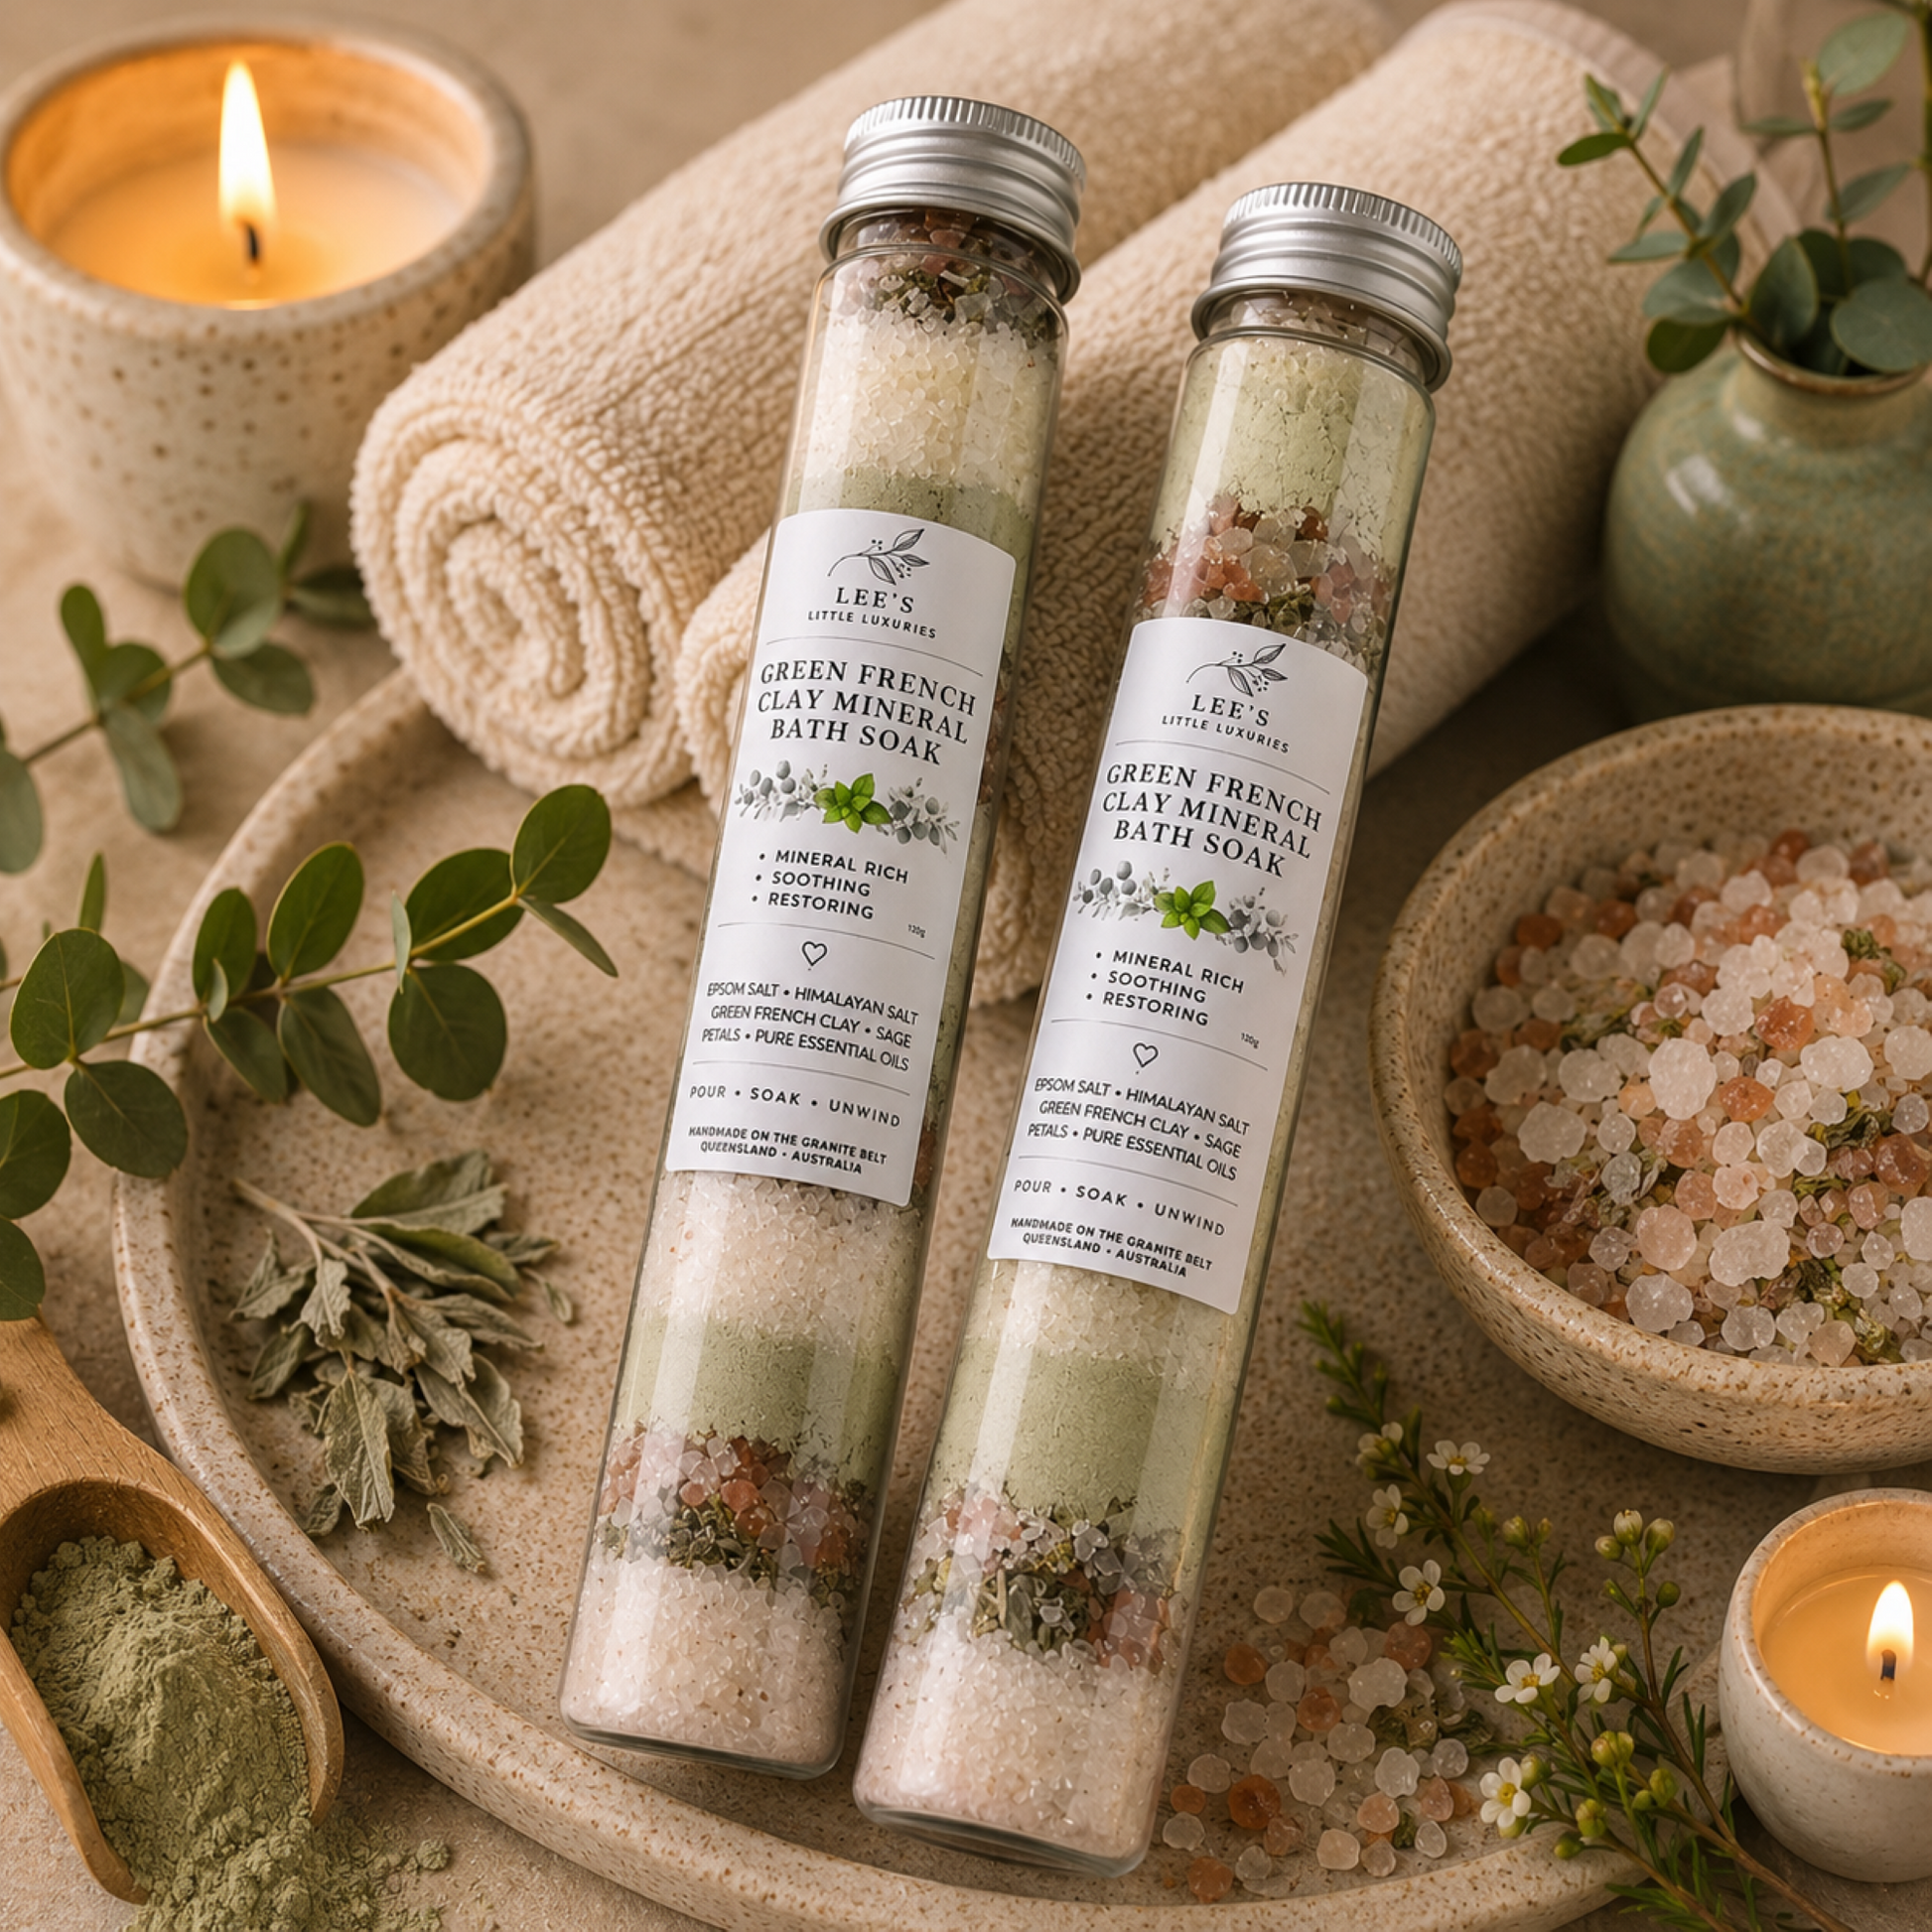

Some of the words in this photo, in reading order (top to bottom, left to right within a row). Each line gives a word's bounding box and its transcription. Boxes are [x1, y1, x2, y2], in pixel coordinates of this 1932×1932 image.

[836, 587, 913, 614] LEE'S
[808, 611, 854, 622] LITTLE
[862, 614, 937, 639] LUXURIES
[760, 659, 848, 684] GREEN
[858, 664, 977, 717] FRENCH
[758, 689, 824, 713] CLAY
[832, 691, 968, 745] MINERAL
[1191, 695, 1270, 727] LEE'S
[770, 719, 850, 743] BATH
[858, 725, 942, 765] SOAK
[1162, 715, 1209, 731] LITTLE
[1216, 723, 1290, 754] LUXURIES
[1106, 762, 1197, 788] GREEN
[1205, 772, 1322, 832] FRENCH
[1102, 791, 1173, 813] CLAY
[1178, 797, 1311, 859] MINERAL
[774, 850, 857, 872] MINERAL
[864, 862, 909, 884] RICH
[1114, 820, 1194, 849] BATH
[1203, 832, 1287, 878] SOAK
[768, 892, 875, 919] RESTORING
[771, 871, 872, 897] SOOTHING
[1108, 970, 1207, 1004] SOOTHING
[1112, 950, 1193, 978] MINERAL
[1201, 968, 1244, 994] RICH
[707, 982, 745, 998] EPSOM
[748, 983, 780, 998] SALT
[794, 987, 886, 1016] HIMALAYAN
[887, 1005, 919, 1026] SALT
[1103, 991, 1209, 1027] RESTORING
[711, 1005, 752, 1019] GREEN
[754, 1006, 817, 1027] FRENCH
[819, 1014, 861, 1034] CLAY
[876, 1026, 912, 1048] SAGE
[702, 1028, 741, 1042] PETALS
[756, 1030, 795, 1046] PURE
[797, 1035, 877, 1062] ESSENTIAL
[880, 1050, 909, 1071] OILS
[690, 1085, 726, 1098] POUR
[751, 1087, 801, 1106] SOAK
[829, 1099, 900, 1127] UNWIND
[1035, 1077, 1074, 1092] EPSOM
[1078, 1079, 1112, 1097] SALT
[1126, 1088, 1216, 1124] HIMALAYAN
[1218, 1113, 1250, 1136] SALT
[688, 1126, 747, 1139] HANDMADE
[752, 1130, 769, 1141] ON
[773, 1133, 797, 1147] THE
[801, 1137, 856, 1157] GRANITE
[860, 1149, 887, 1165] BELT
[1039, 1100, 1080, 1116] GREEN
[1084, 1104, 1146, 1127] FRENCH
[1150, 1117, 1190, 1139] CLAY
[1203, 1134, 1242, 1159] SAGE
[700, 1141, 777, 1158] QUEENSLAND
[790, 1151, 863, 1174] AUSTRALIA
[1028, 1123, 1068, 1138] PETALS
[1083, 1127, 1123, 1147] PURE
[1126, 1135, 1203, 1170] ESSENTIAL
[1206, 1159, 1237, 1181] OILS
[1014, 1178, 1051, 1193] POUR
[1075, 1185, 1127, 1207] SOAK
[1154, 1202, 1225, 1236] UNWIND
[1011, 1217, 1073, 1233] HANDMADE
[1076, 1225, 1095, 1238] ON
[1099, 1229, 1124, 1245] THE
[1126, 1236, 1182, 1261] GRANITE
[1023, 1233, 1101, 1253] QUEENSLAND
[1115, 1248, 1187, 1278] AUSTRALIA
